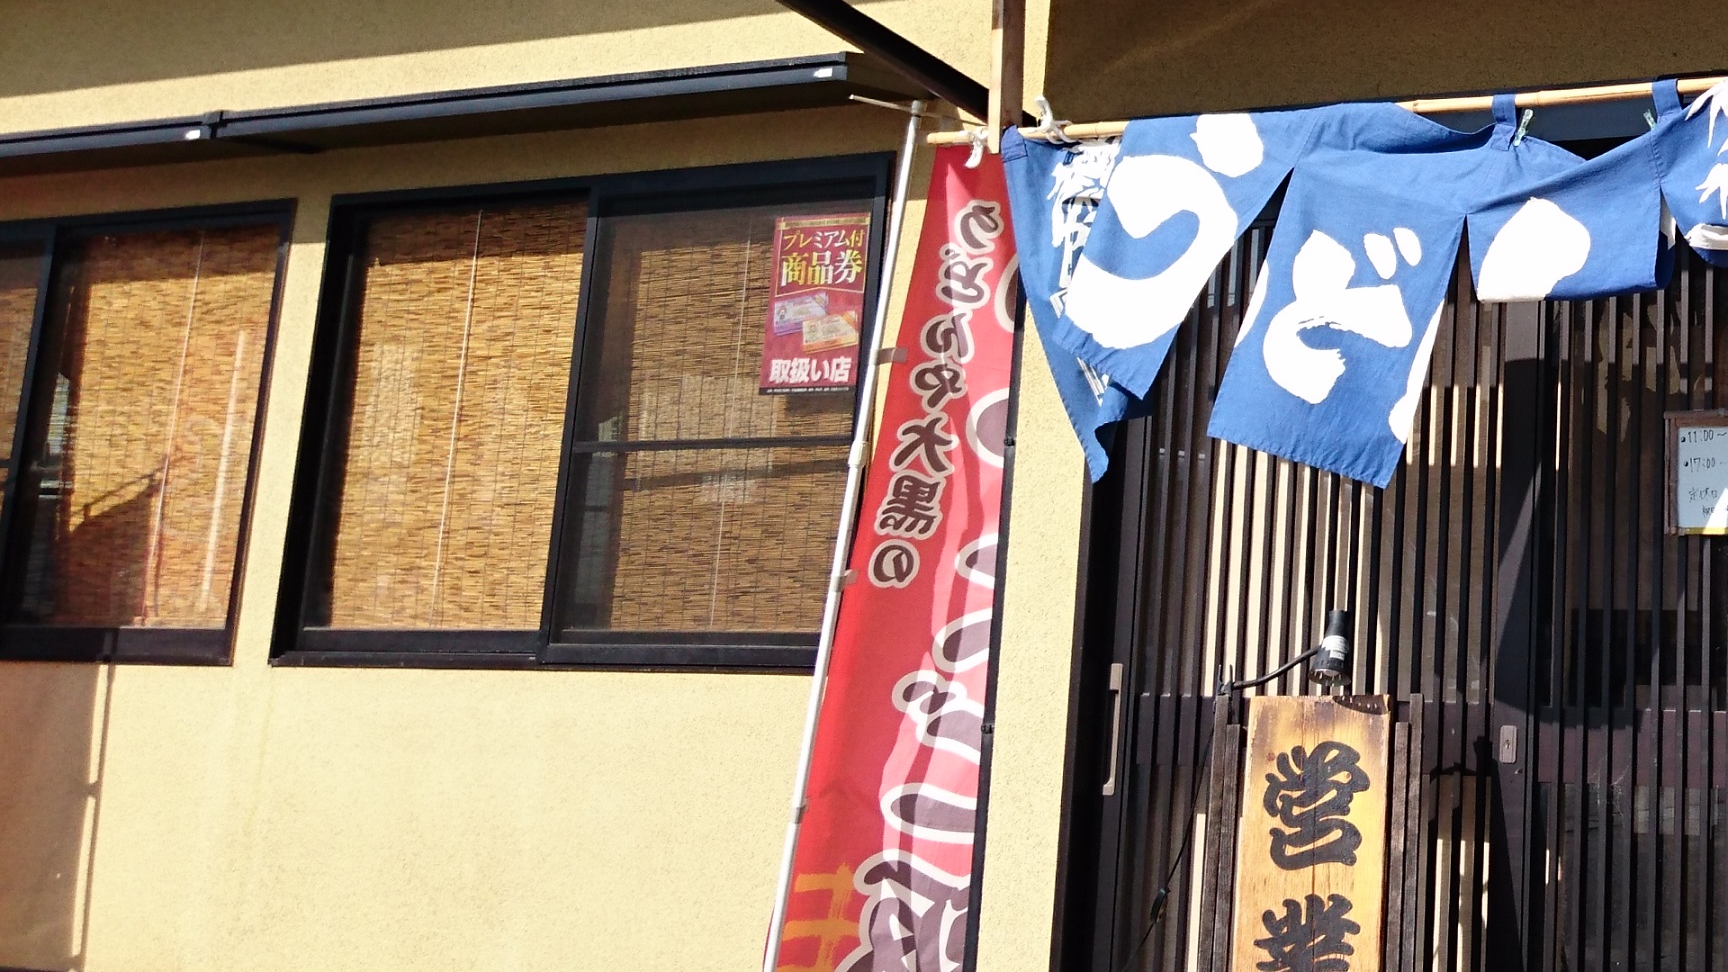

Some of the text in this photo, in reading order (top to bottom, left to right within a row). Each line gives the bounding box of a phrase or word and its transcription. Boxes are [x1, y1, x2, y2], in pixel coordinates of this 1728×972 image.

[783, 229, 866, 251] プレミアム付
[780, 249, 863, 287] 商品券
[769, 356, 852, 384] 取扱い店
